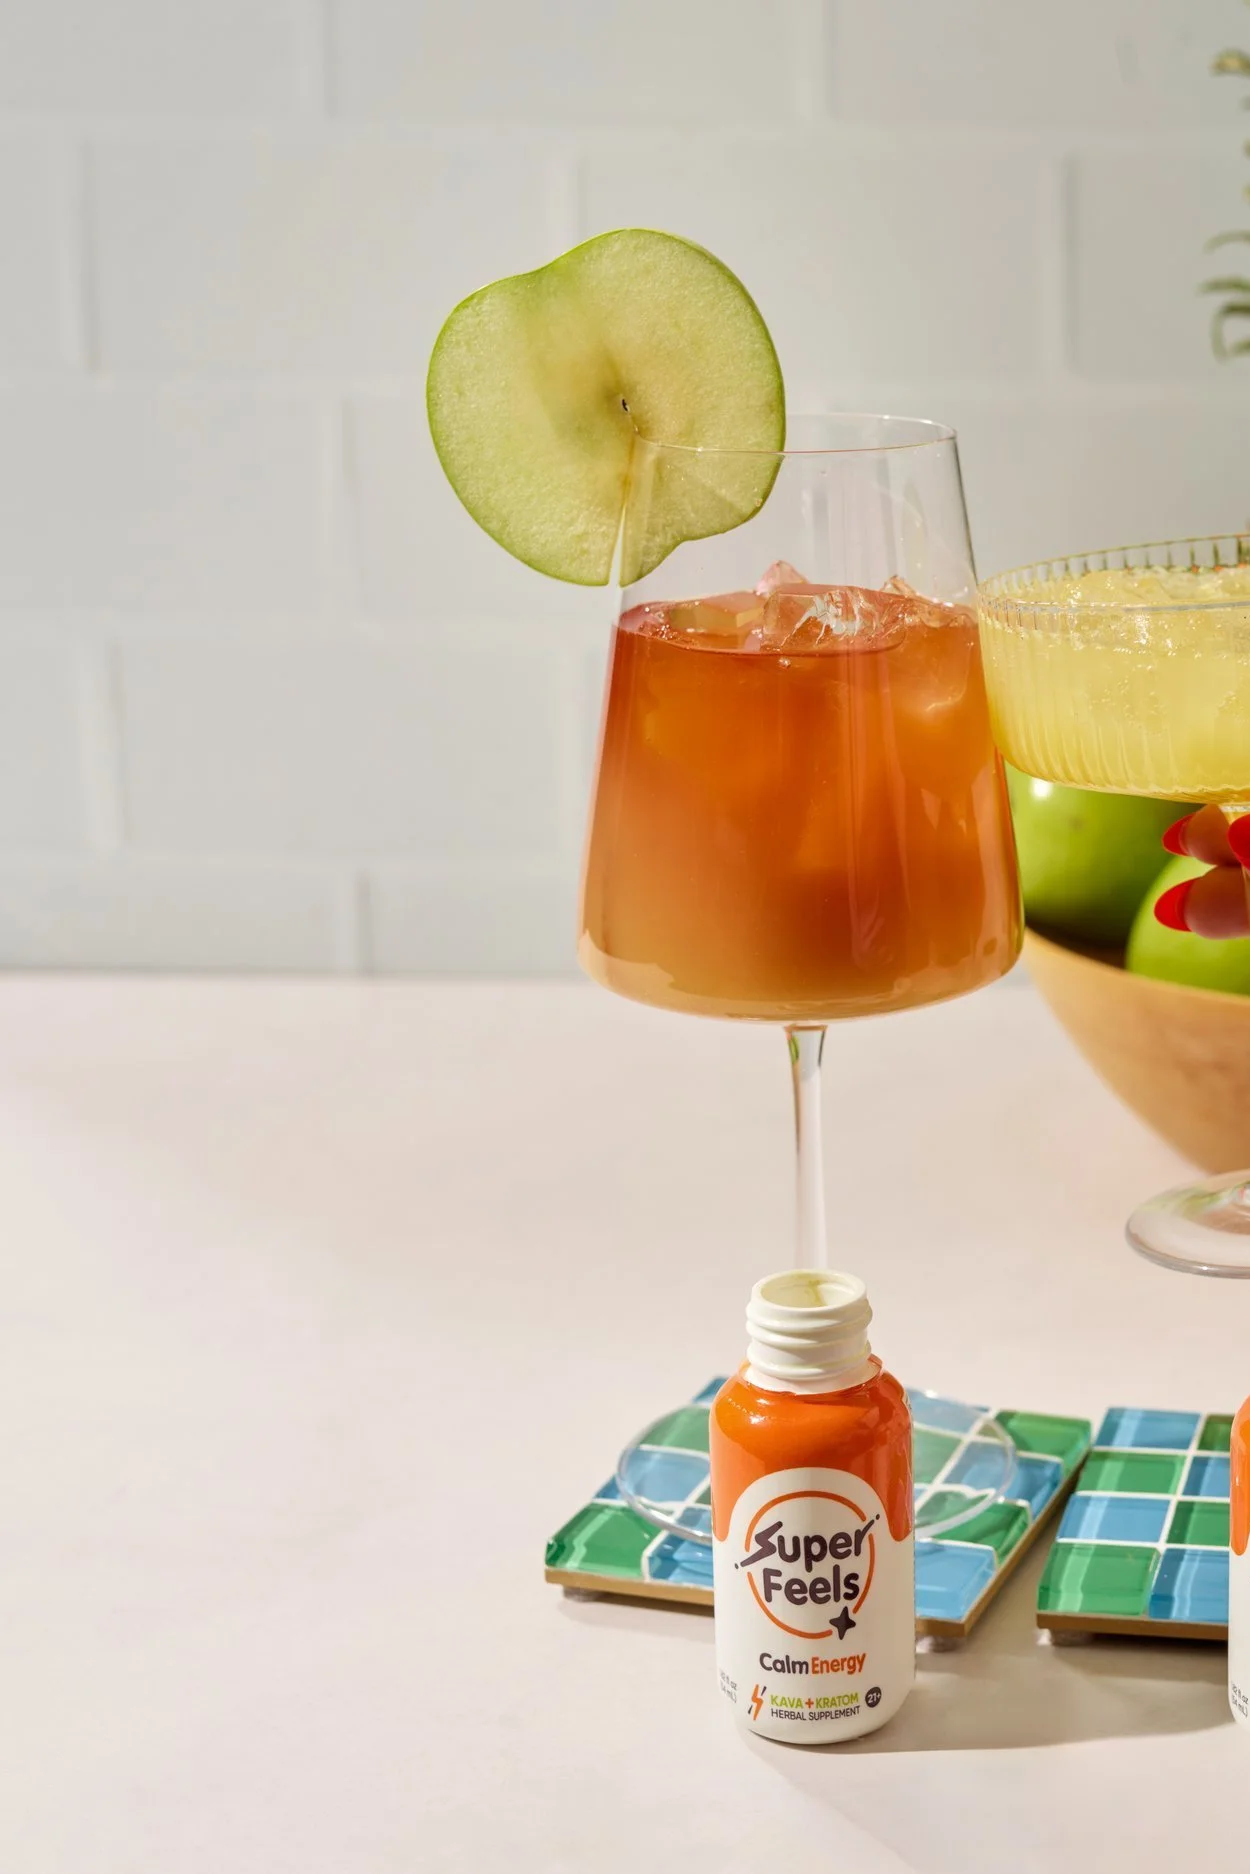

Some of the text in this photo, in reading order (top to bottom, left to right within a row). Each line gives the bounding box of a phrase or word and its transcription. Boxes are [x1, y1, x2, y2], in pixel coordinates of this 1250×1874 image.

[739, 1518, 876, 1573] Super
[762, 1564, 860, 1606] Feels
[759, 1652, 866, 1675] Calm Energy
[770, 1694, 804, 1709] KAVA
[815, 1692, 859, 1709] KRATOM
[771, 1705, 861, 1721] HERBAL SUPPLEMENT
